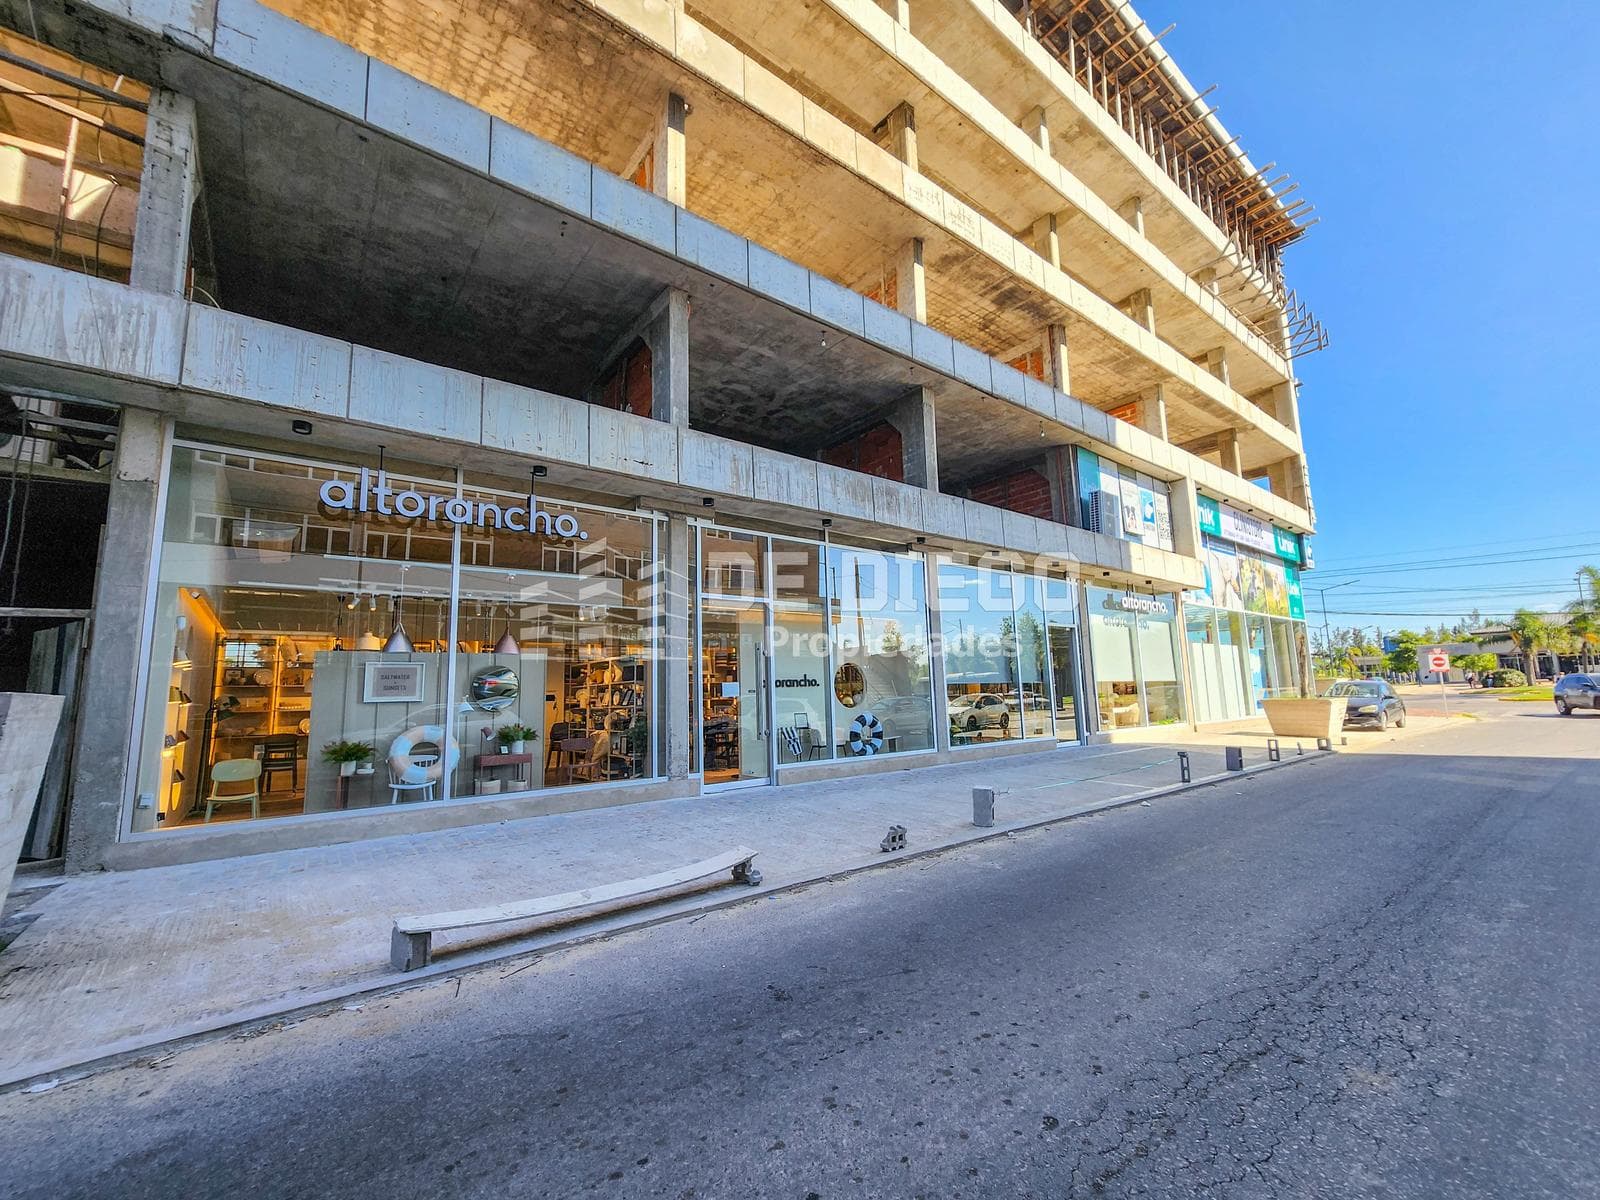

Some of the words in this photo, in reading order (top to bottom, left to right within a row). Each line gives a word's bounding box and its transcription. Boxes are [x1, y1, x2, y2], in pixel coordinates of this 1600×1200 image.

[319, 467, 589, 540] altorancho.
[1199, 503, 1215, 526] nik
[763, 674, 820, 688] orancho.
